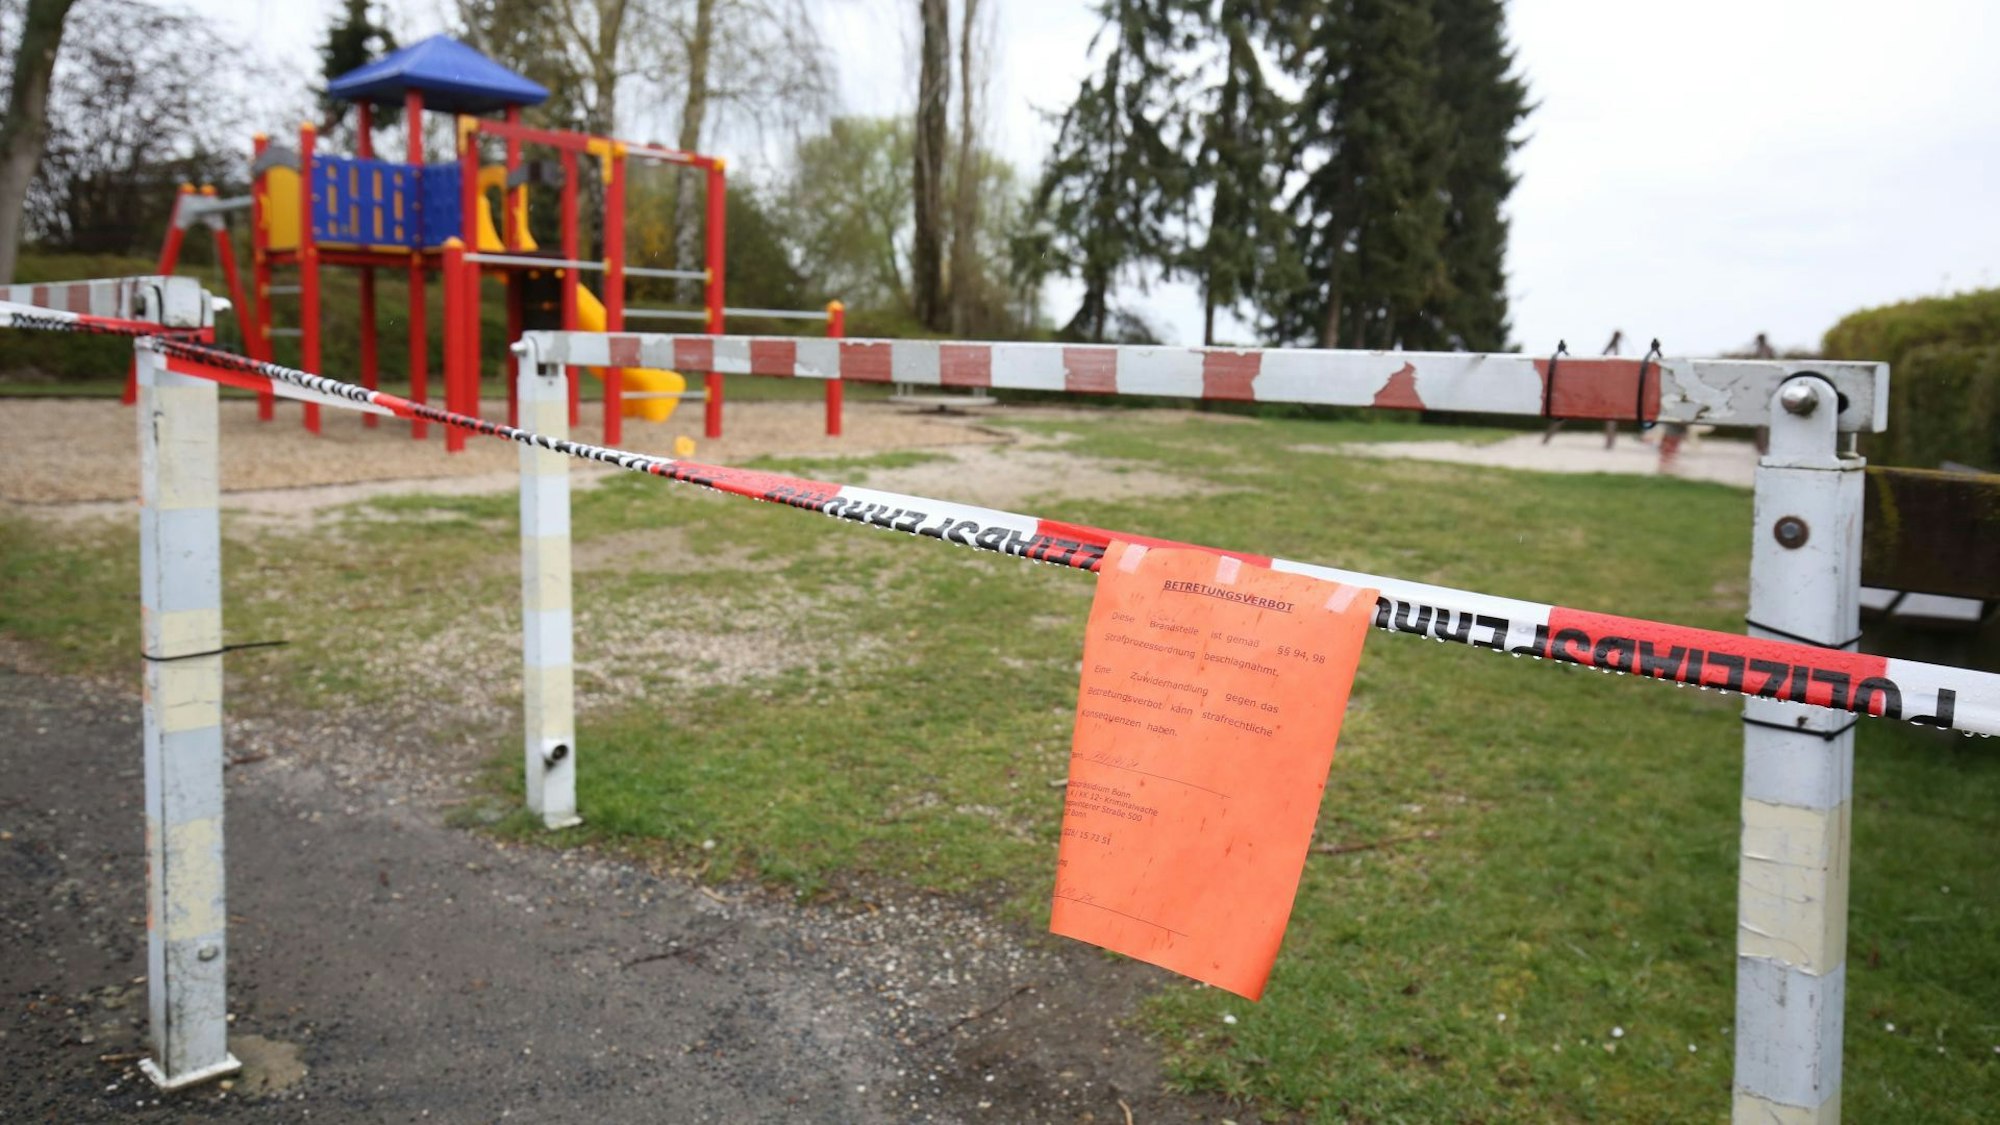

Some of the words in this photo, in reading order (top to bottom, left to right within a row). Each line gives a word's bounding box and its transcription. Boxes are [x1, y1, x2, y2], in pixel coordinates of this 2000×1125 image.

[1163, 580, 1295, 612] BETRETUNGSVERBOT
[1104, 632, 1196, 659] Strafprozessordnung
[1111, 611, 1135, 623] Diese
[1149, 620, 1199, 635] Brandstelle
[1210, 631, 1222, 640] ist
[1277, 645, 1291, 657] §§
[1293, 649, 1309, 662] 94,
[1312, 653, 1326, 664] 98
[1094, 664, 1111, 674] Eine
[1129, 671, 1209, 697] Zuwiderhandlung
[1225, 692, 1257, 708] gegen
[1260, 702, 1280, 714] das
[1081, 709, 1142, 729] Konsequenzen
[1146, 722, 1178, 737] haben.
[1087, 686, 1163, 710] Betretungsverbot
[1170, 703, 1193, 716] kann
[1201, 711, 1274, 738] strafrechtliche
[1104, 796, 1160, 817] Kriminalwache
[1111, 787, 1131, 799] Bonn
[1070, 810, 1087, 818] Bonn
[1101, 805, 1126, 818] Straße
[1127, 812, 1143, 822] 500
[1079, 832, 1088, 840] 15
[1090, 834, 1101, 843] 73
